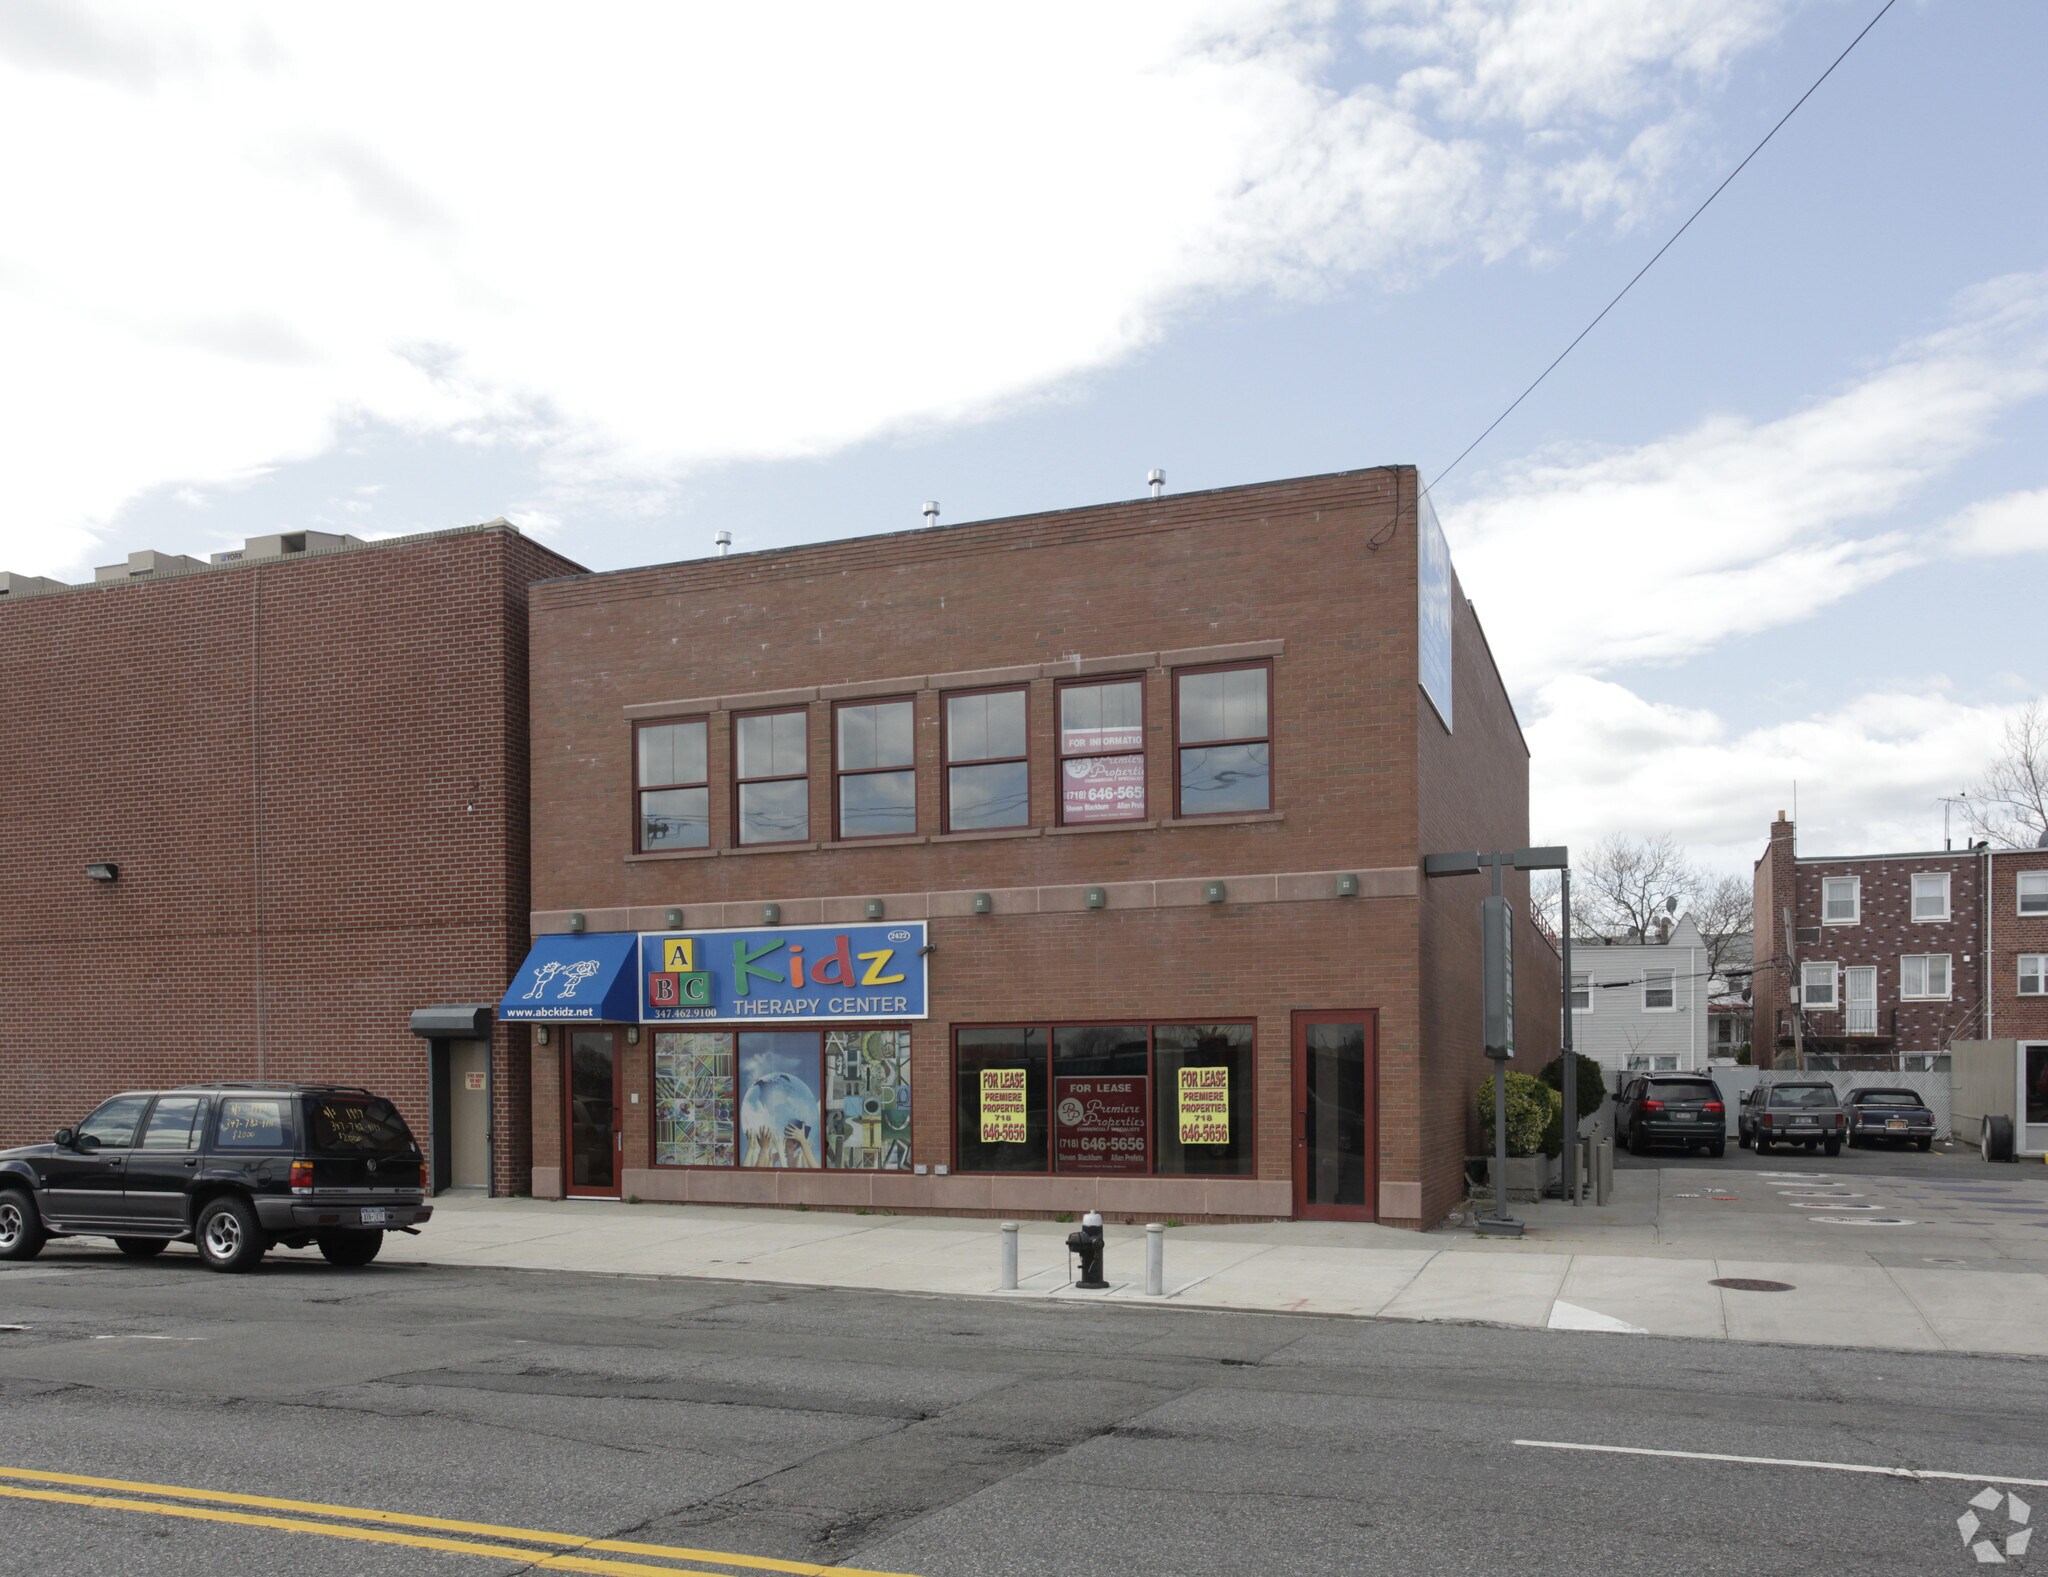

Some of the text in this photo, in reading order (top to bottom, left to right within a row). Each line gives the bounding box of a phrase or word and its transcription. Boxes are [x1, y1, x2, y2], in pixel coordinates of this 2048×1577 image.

[1068, 739, 1086, 747] FOR
[1067, 786, 1144, 800] (718) 646-565
[732, 935, 905, 996] Kidz
[507, 1006, 593, 1017] www.abckidz.net
[733, 996, 907, 1014] THERAPY CENTER
[655, 1008, 716, 1018] 347.462.9100
[983, 1072, 1024, 1088] FOR LEASE
[1181, 1070, 1226, 1087] FOR LEASE
[1070, 1084, 1132, 1092] FOR LEASE
[985, 1092, 1022, 1101] PREMIERE
[1184, 1092, 1224, 1101] PREMIERE
[983, 1104, 1024, 1113] PROPERTIES
[1087, 1100, 1140, 1113] Premiere
[1181, 1103, 1226, 1113] PROPERTIES
[1082, 1112, 1144, 1131] Properties
[983, 1123, 1024, 1140] 646-5656
[1181, 1124, 1227, 1142] 646-5656
[1060, 1137, 1144, 1150] (718) 646-5656
